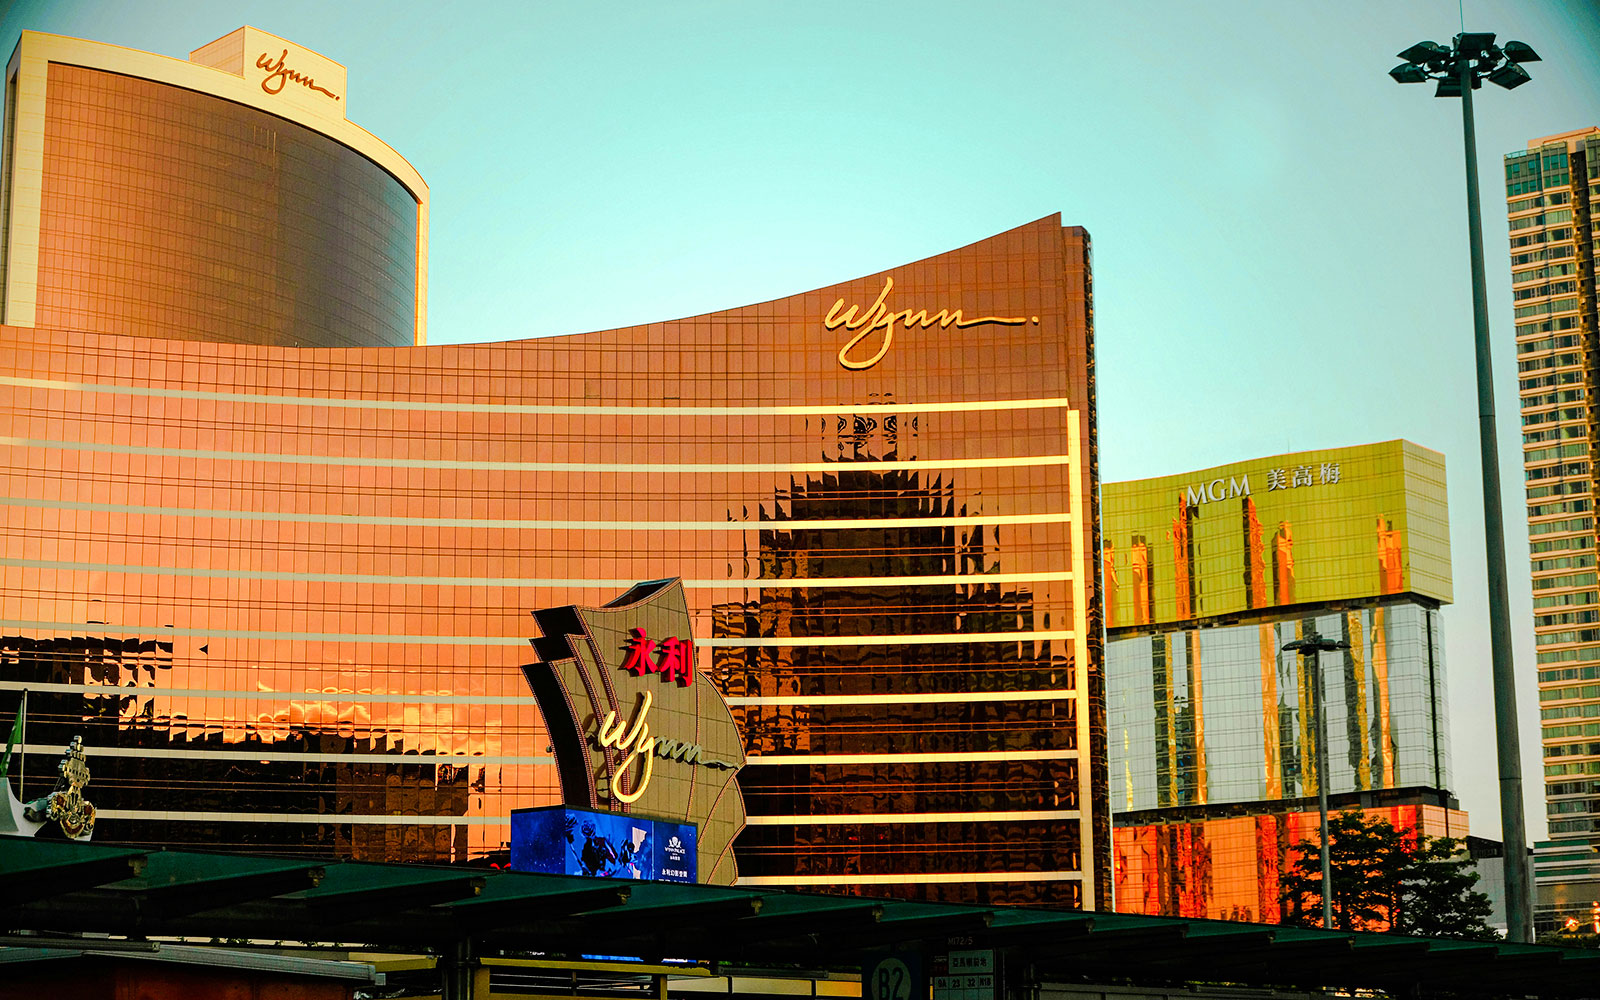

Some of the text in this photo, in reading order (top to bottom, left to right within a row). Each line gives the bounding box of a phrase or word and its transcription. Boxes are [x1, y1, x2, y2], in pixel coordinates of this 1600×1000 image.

[1186, 474, 1251, 507] MGM
[1266, 462, 1340, 492] 美高梅
[622, 627, 693, 688] 永利
[879, 967, 904, 1000] B2
[937, 978, 947, 988] 9A
[952, 978, 961, 988] 23
[967, 977, 976, 987] 32
